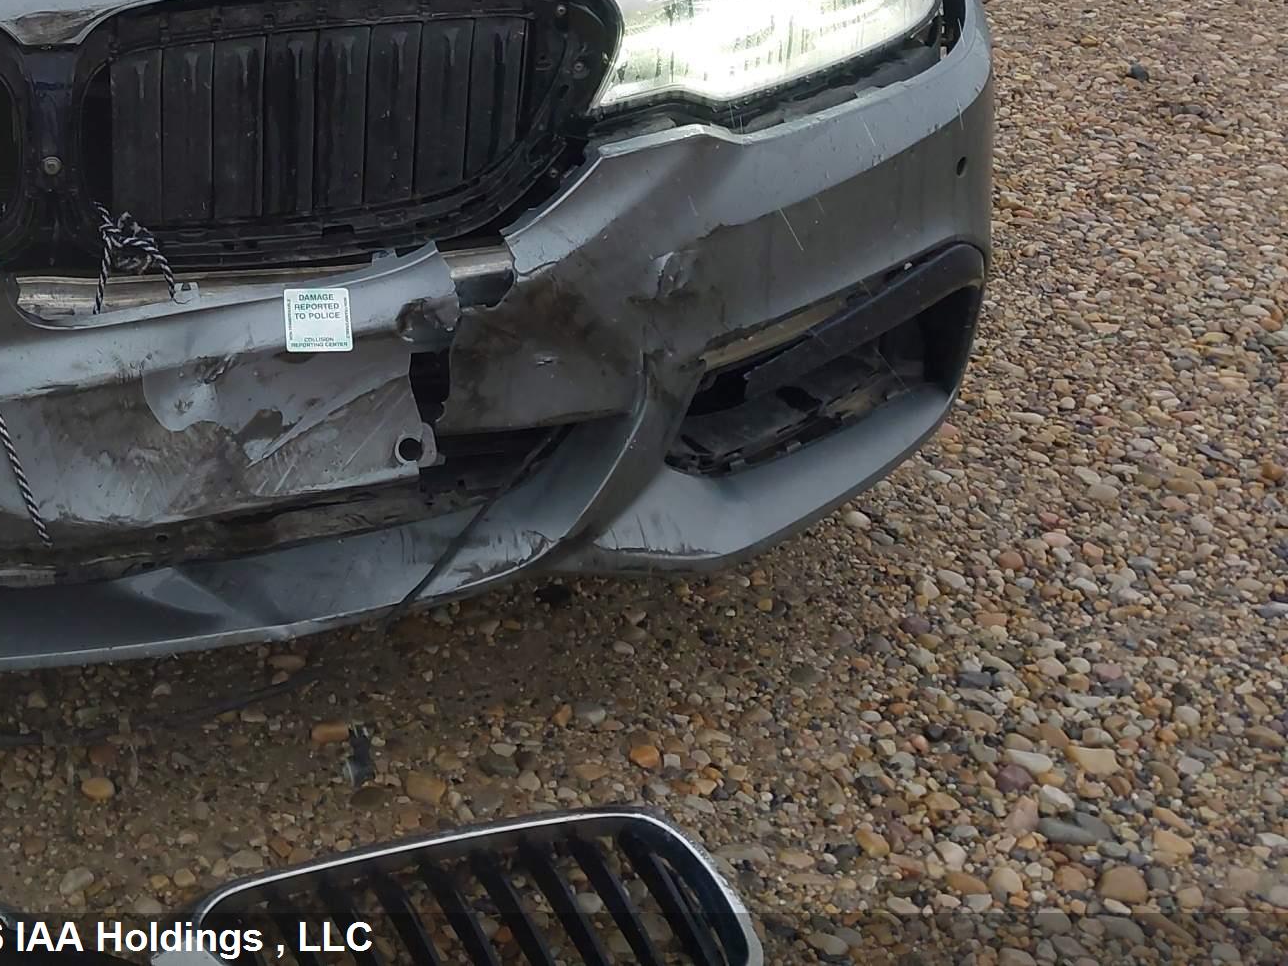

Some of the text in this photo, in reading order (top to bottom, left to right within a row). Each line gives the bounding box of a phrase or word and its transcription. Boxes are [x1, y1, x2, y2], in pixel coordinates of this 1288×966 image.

[298, 293, 335, 301] DAMAGE
[294, 303, 340, 311] REPORTED
[295, 311, 342, 320] TO POLICE
